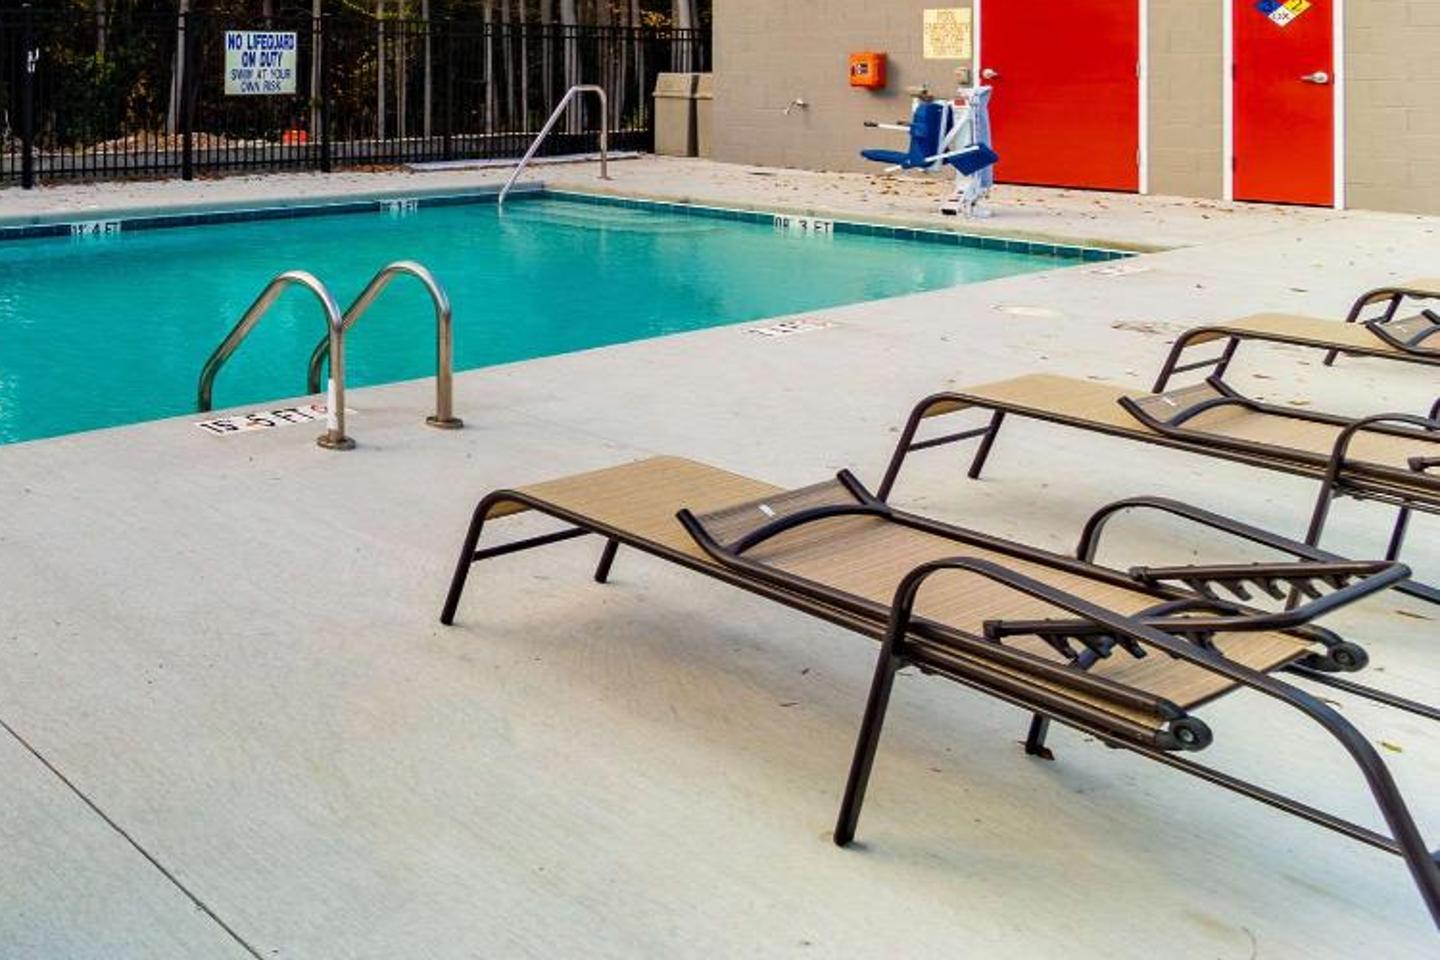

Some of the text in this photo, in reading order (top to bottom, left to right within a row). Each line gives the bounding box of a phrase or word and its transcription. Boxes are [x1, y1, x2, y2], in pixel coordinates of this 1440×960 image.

[228, 34, 294, 50] NO LIFEGUARD
[242, 52, 283, 67] ON DUTY
[257, 69, 267, 79] AT
[271, 69, 291, 79] YOUR
